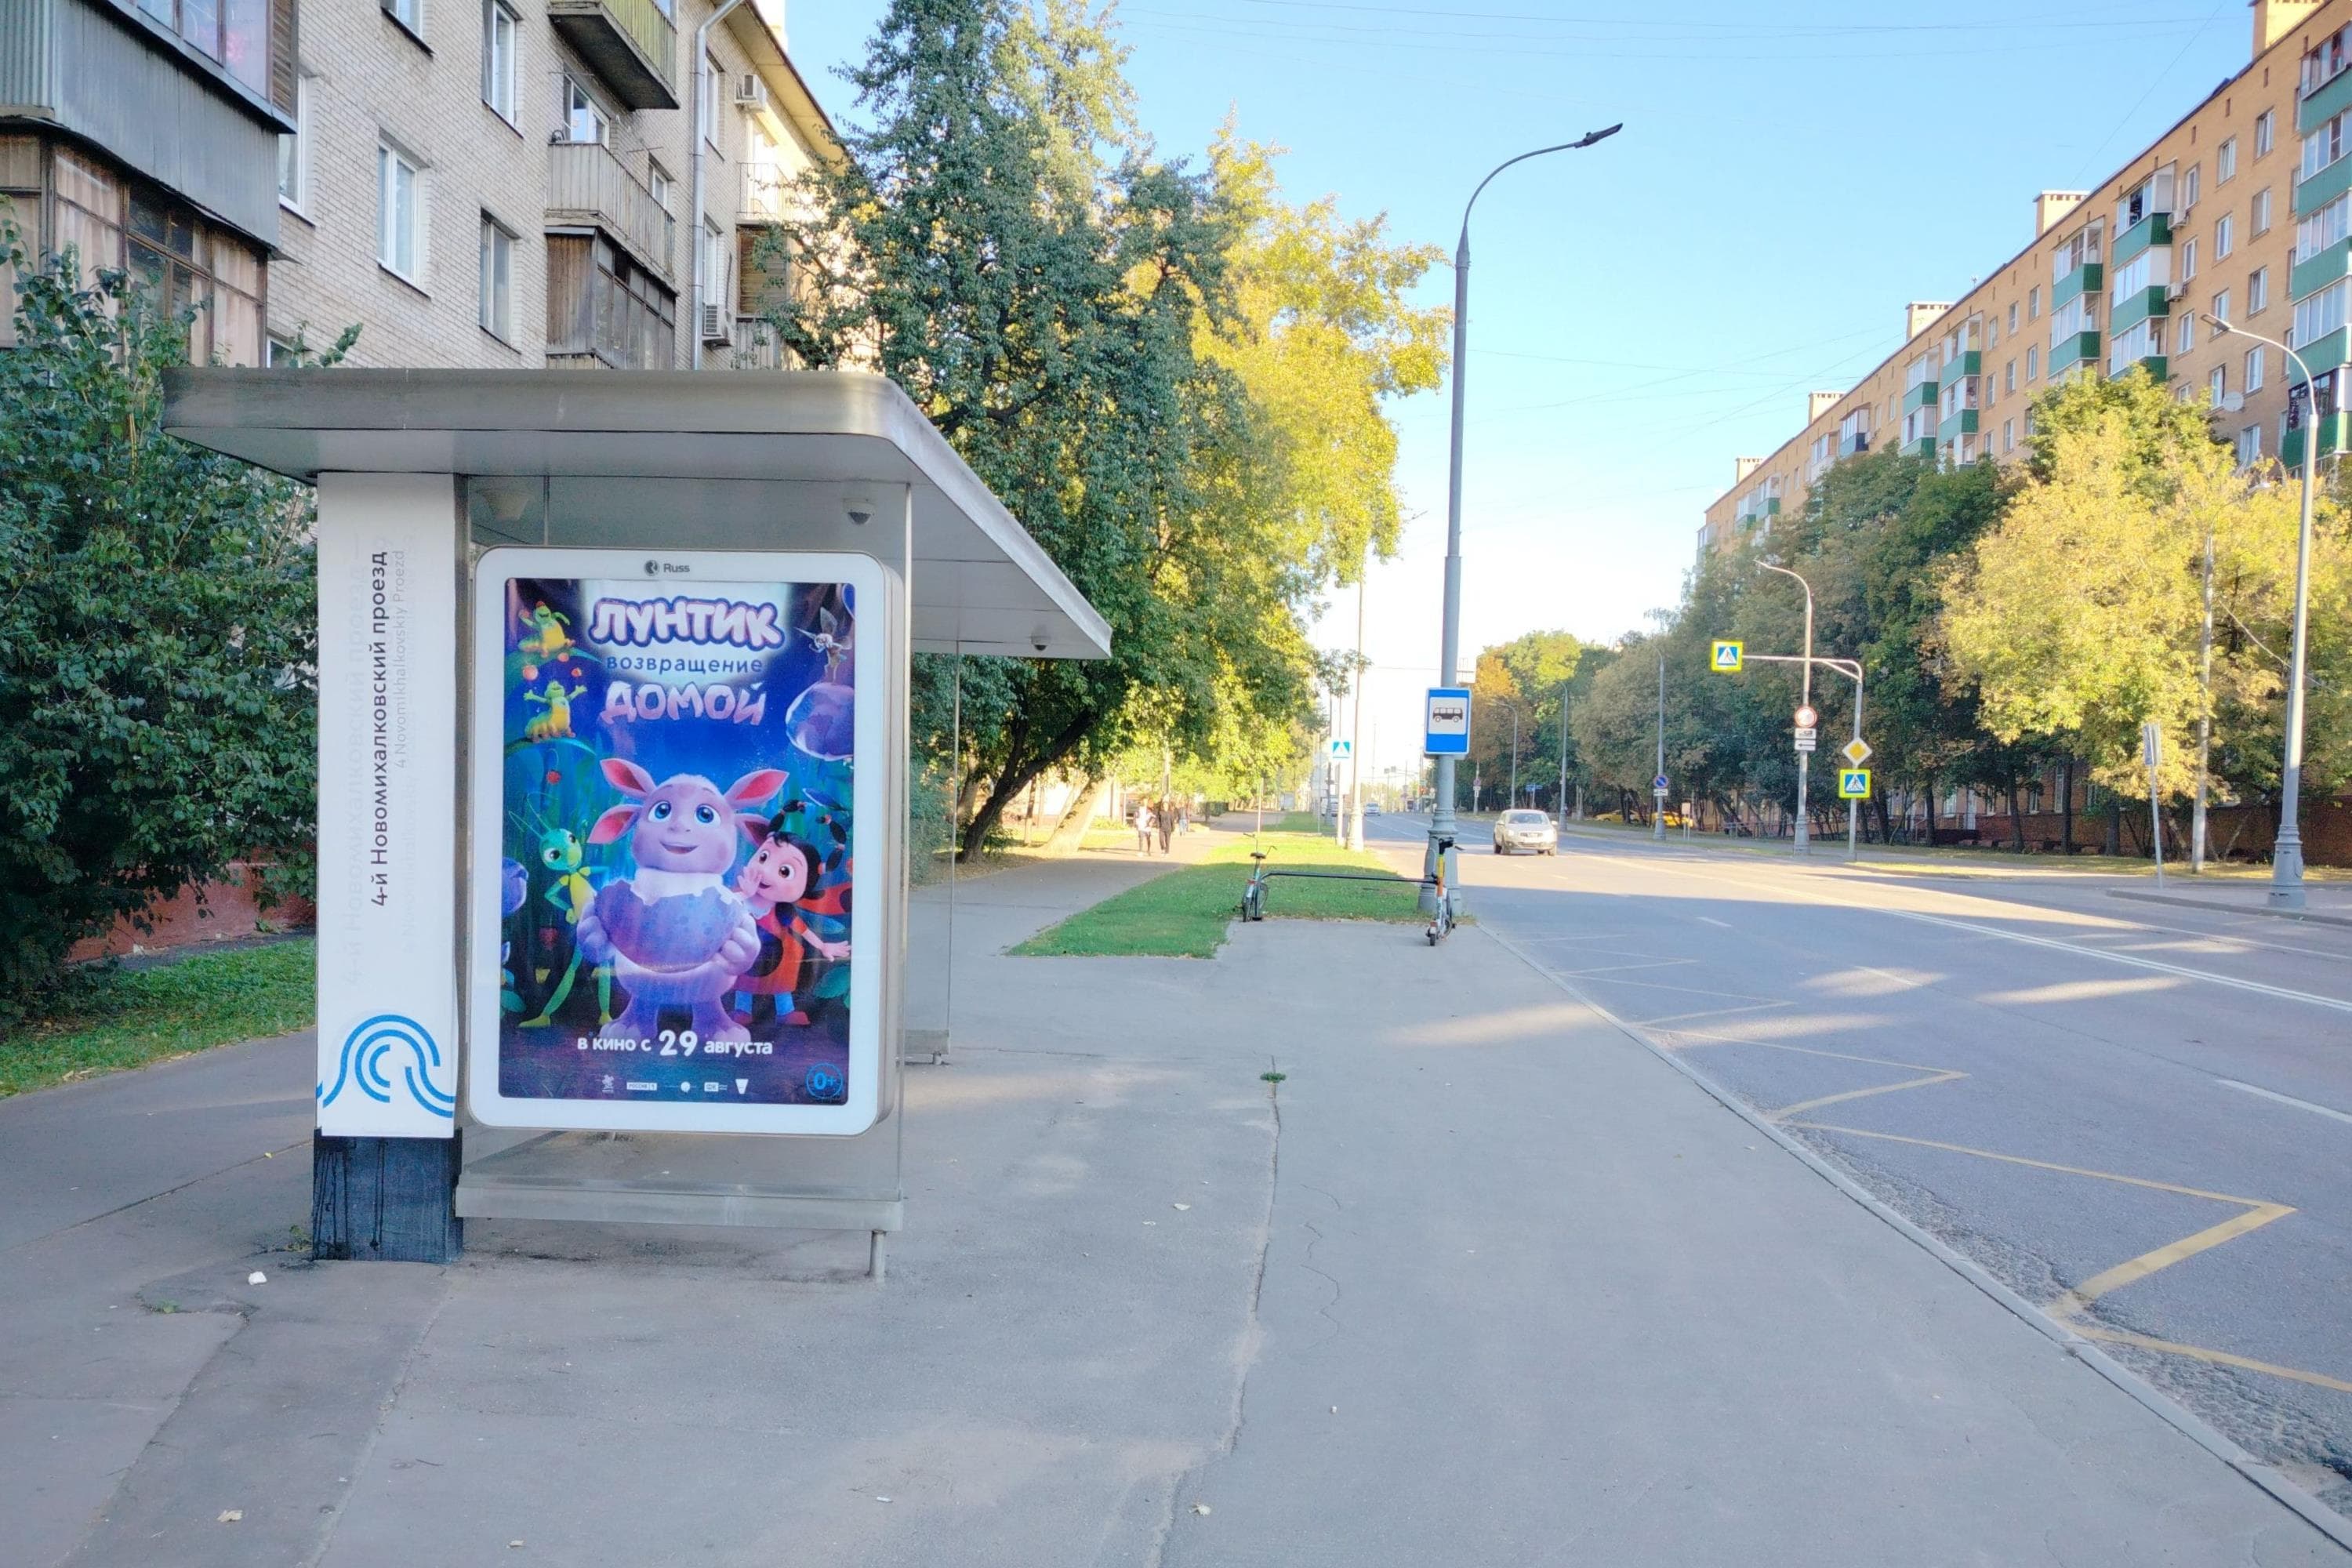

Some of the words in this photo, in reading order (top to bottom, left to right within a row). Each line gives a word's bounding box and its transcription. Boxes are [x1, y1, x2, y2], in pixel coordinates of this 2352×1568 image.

[392, 550, 405, 603] Proezd
[663, 563, 691, 573] Russ
[372, 551, 390, 634] проезд
[589, 596, 784, 652] ЛУНТИК
[393, 606, 408, 755] Novomikhalkovskiy
[606, 656, 763, 675] возвращение
[599, 681, 767, 726] ДОМОЙ
[368, 641, 389, 865] Новомихалковский
[394, 759, 407, 768] 4
[371, 873, 388, 906] 4-й
[592, 1036, 636, 1052] кино
[641, 1039, 652, 1052] с
[658, 1029, 699, 1057] 29
[704, 1040, 773, 1057] августа
[815, 1072, 838, 1090] 0+
